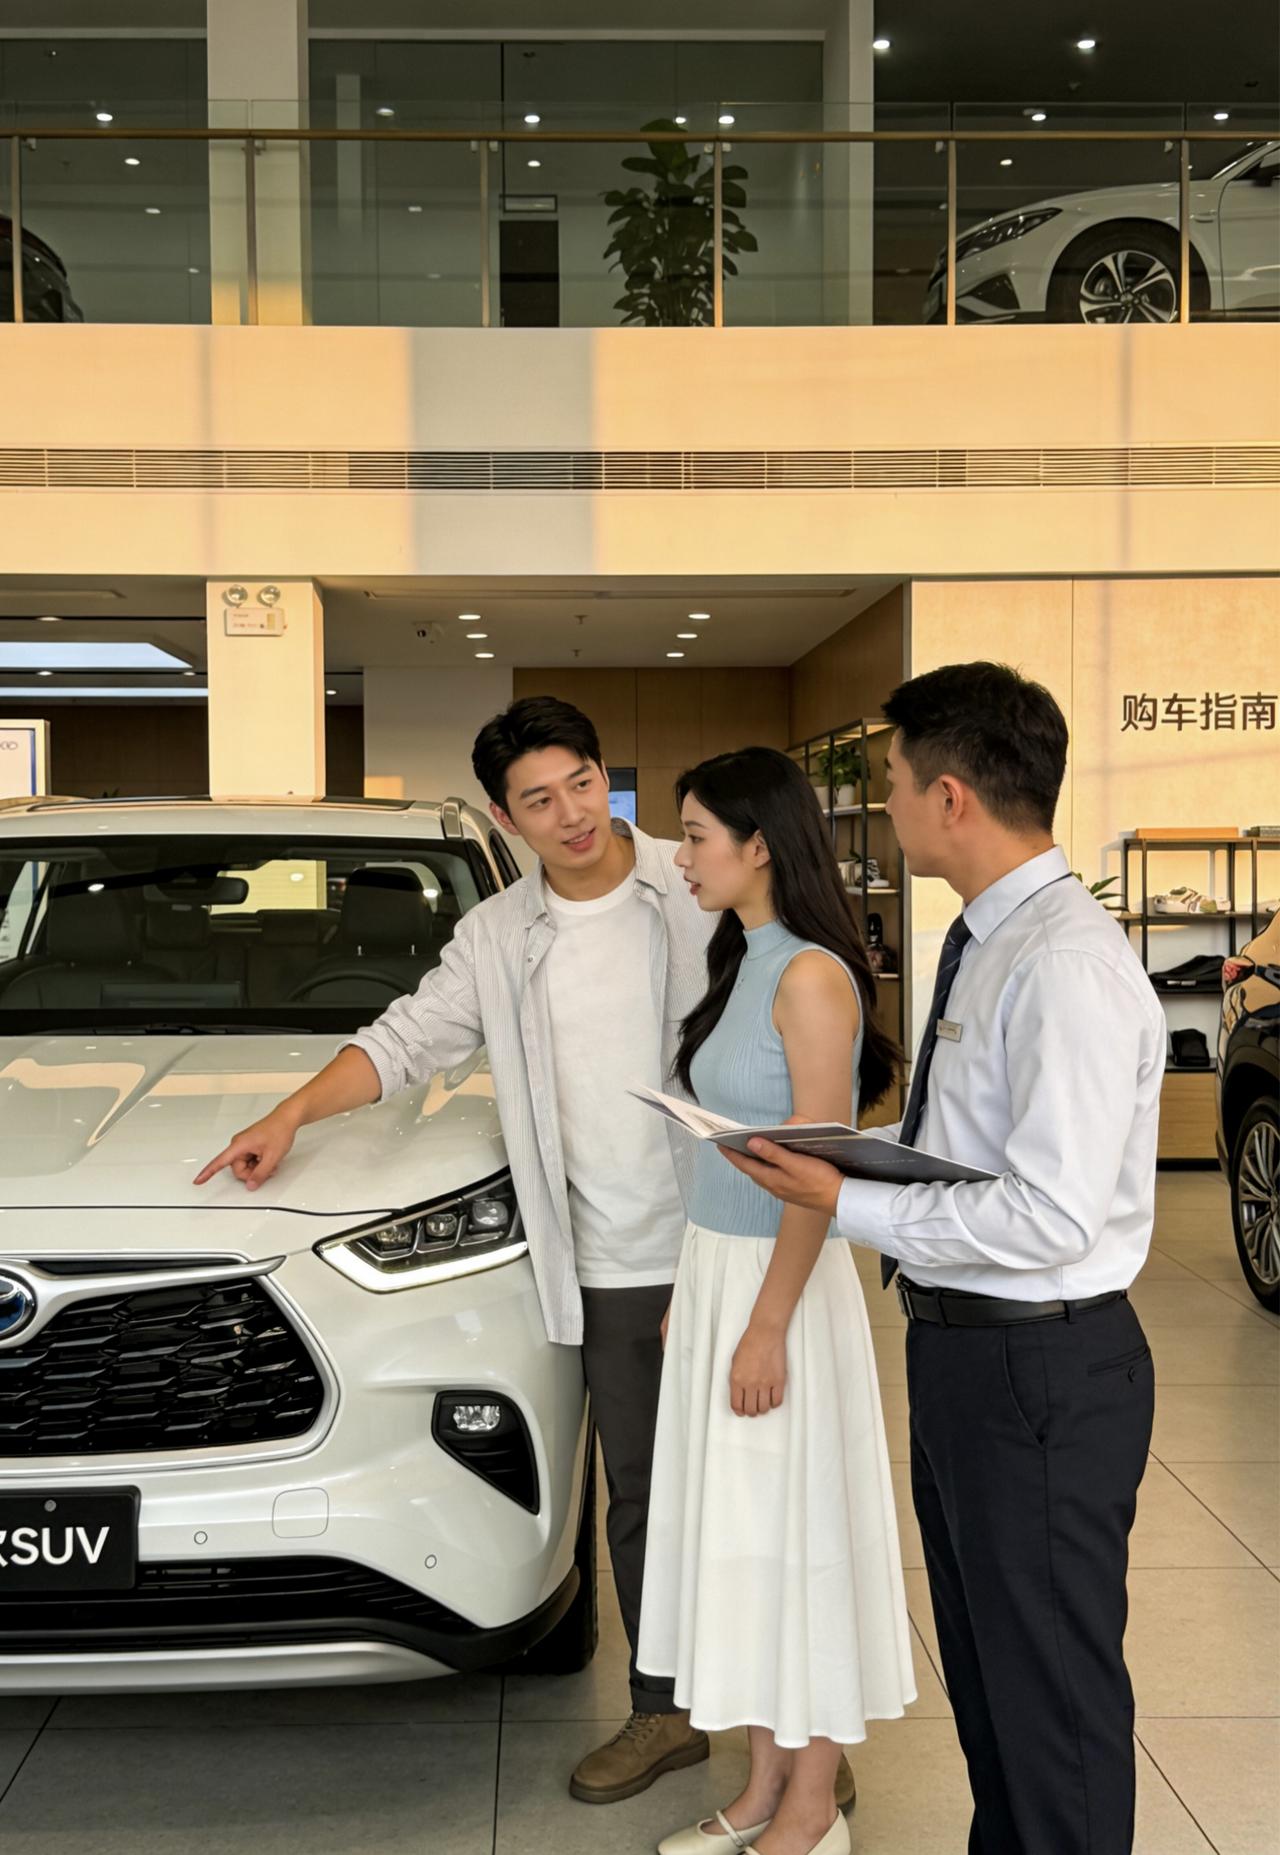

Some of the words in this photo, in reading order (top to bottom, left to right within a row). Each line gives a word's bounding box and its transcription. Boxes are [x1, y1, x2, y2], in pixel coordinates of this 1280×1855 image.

[1121, 692, 1278, 732] 购车指南
[0, 1526, 110, 1567] SUV
